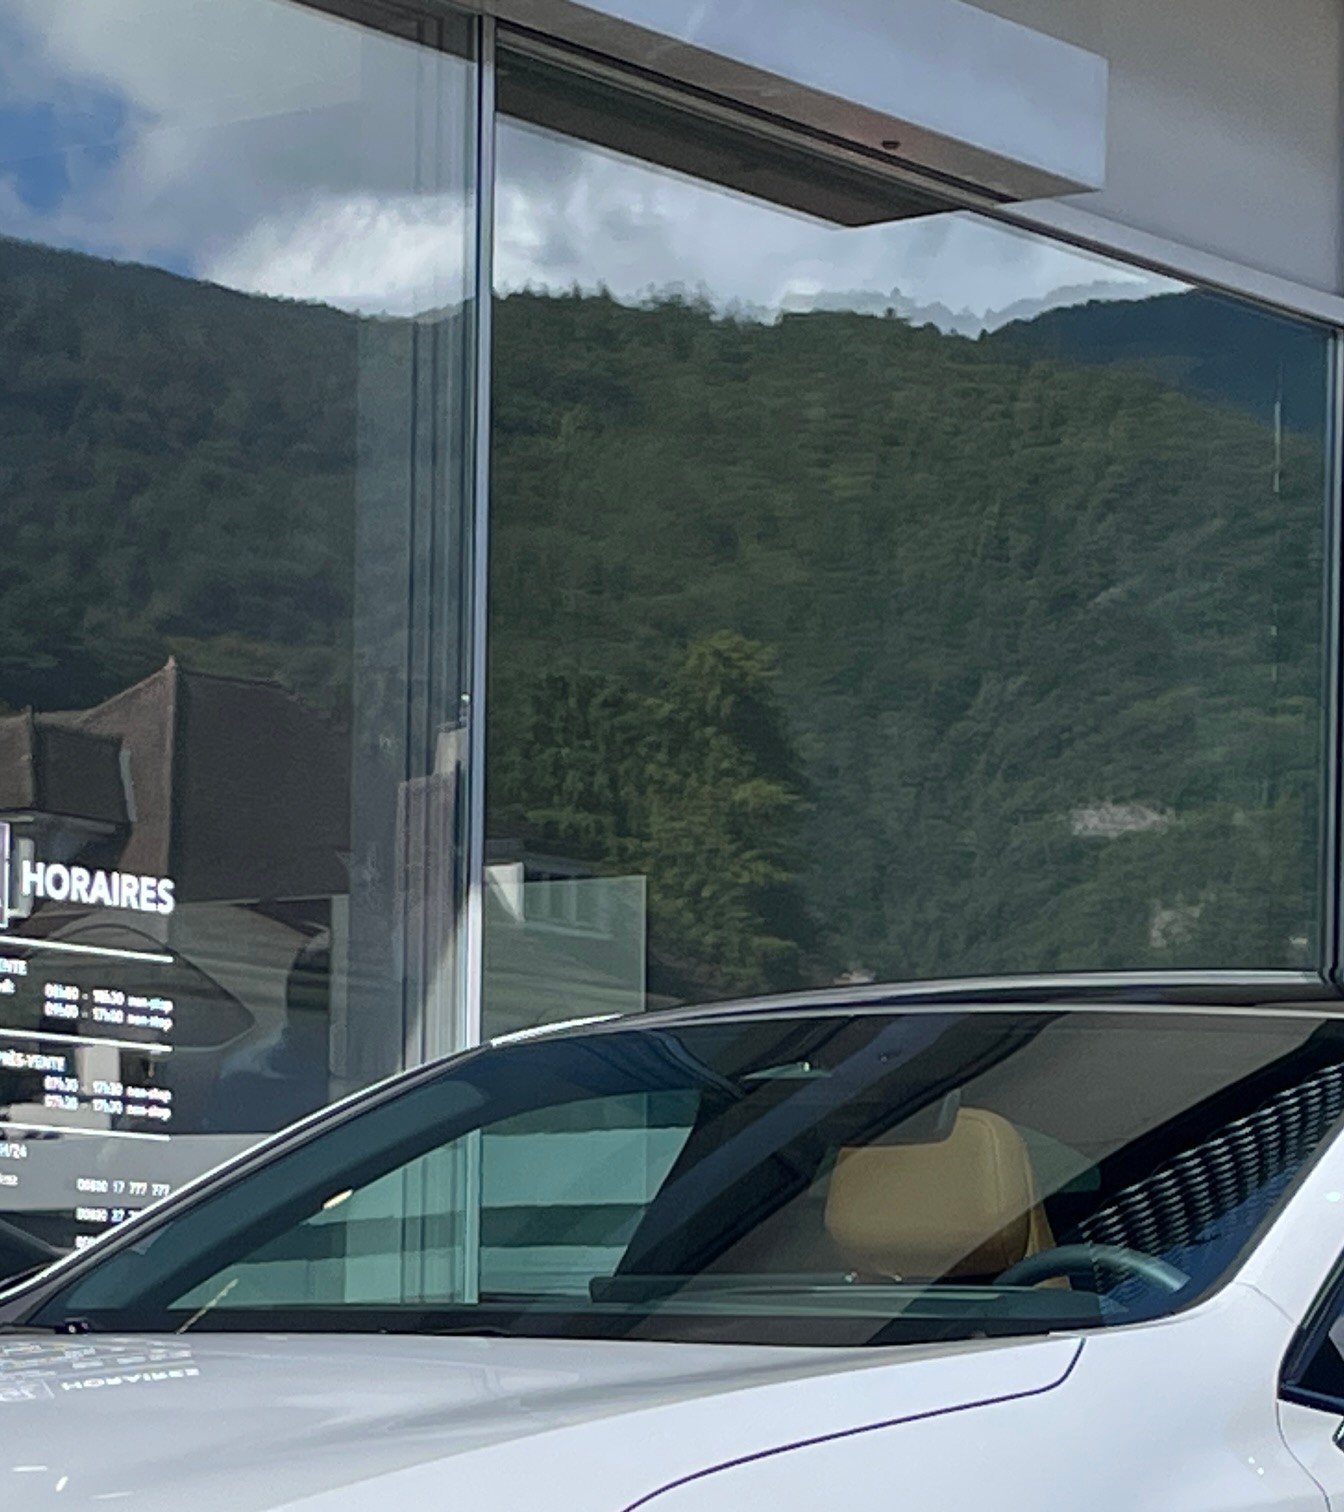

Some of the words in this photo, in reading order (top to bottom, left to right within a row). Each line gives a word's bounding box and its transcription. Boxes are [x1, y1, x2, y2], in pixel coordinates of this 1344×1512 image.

[21, 859, 176, 914] HORAIRES
[128, 996, 173, 1014] non-stop
[128, 1014, 173, 1031] non-stop
[127, 1087, 171, 1103] non-stop
[127, 1105, 171, 1121] non-stop
